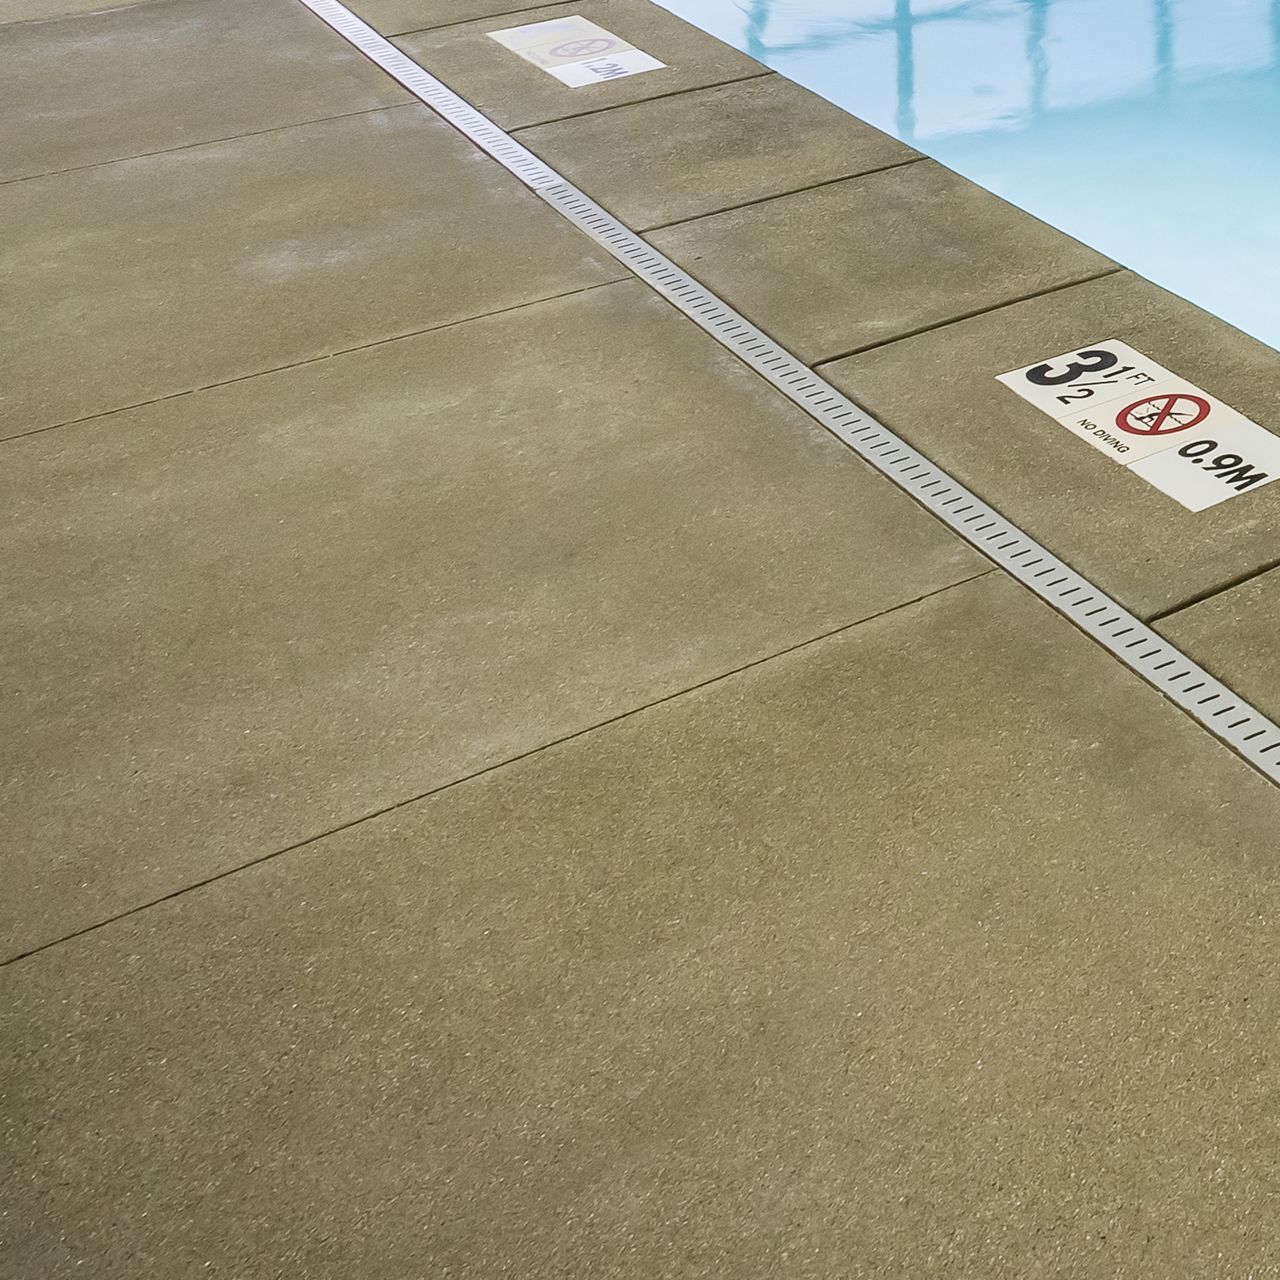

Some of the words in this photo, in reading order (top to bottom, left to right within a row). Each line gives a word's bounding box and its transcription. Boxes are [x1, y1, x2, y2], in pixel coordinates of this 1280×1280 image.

[1025, 350, 1118, 386] 3
[1126, 371, 1155, 386] FT
[1077, 418, 1097, 430] NO
[1093, 429, 1130, 453] DIVING
[1178, 440, 1269, 492] 0.9M
